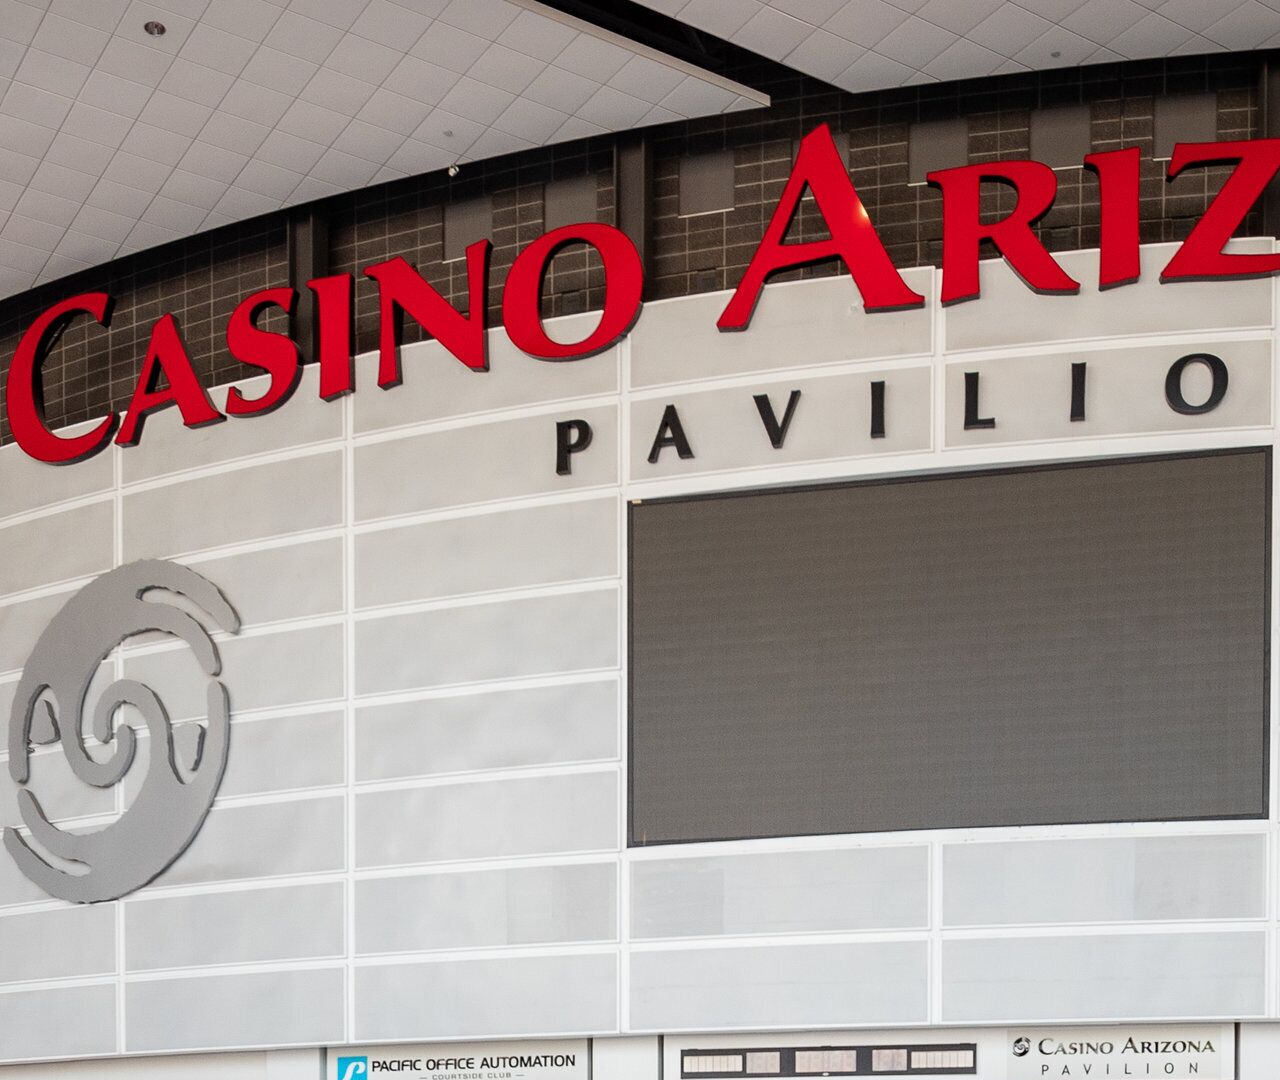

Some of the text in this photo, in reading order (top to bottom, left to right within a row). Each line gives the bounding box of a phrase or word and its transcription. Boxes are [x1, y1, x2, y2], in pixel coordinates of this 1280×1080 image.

[7, 222, 644, 465] CASINO
[1038, 1036, 1216, 1055] CASINO ARIZONA
[372, 1054, 576, 1073] PACIFIC OFFICE AUTOMATION
[1041, 1062, 1199, 1076] PAVILION
[432, 1072, 483, 1080] COURTSIDE
